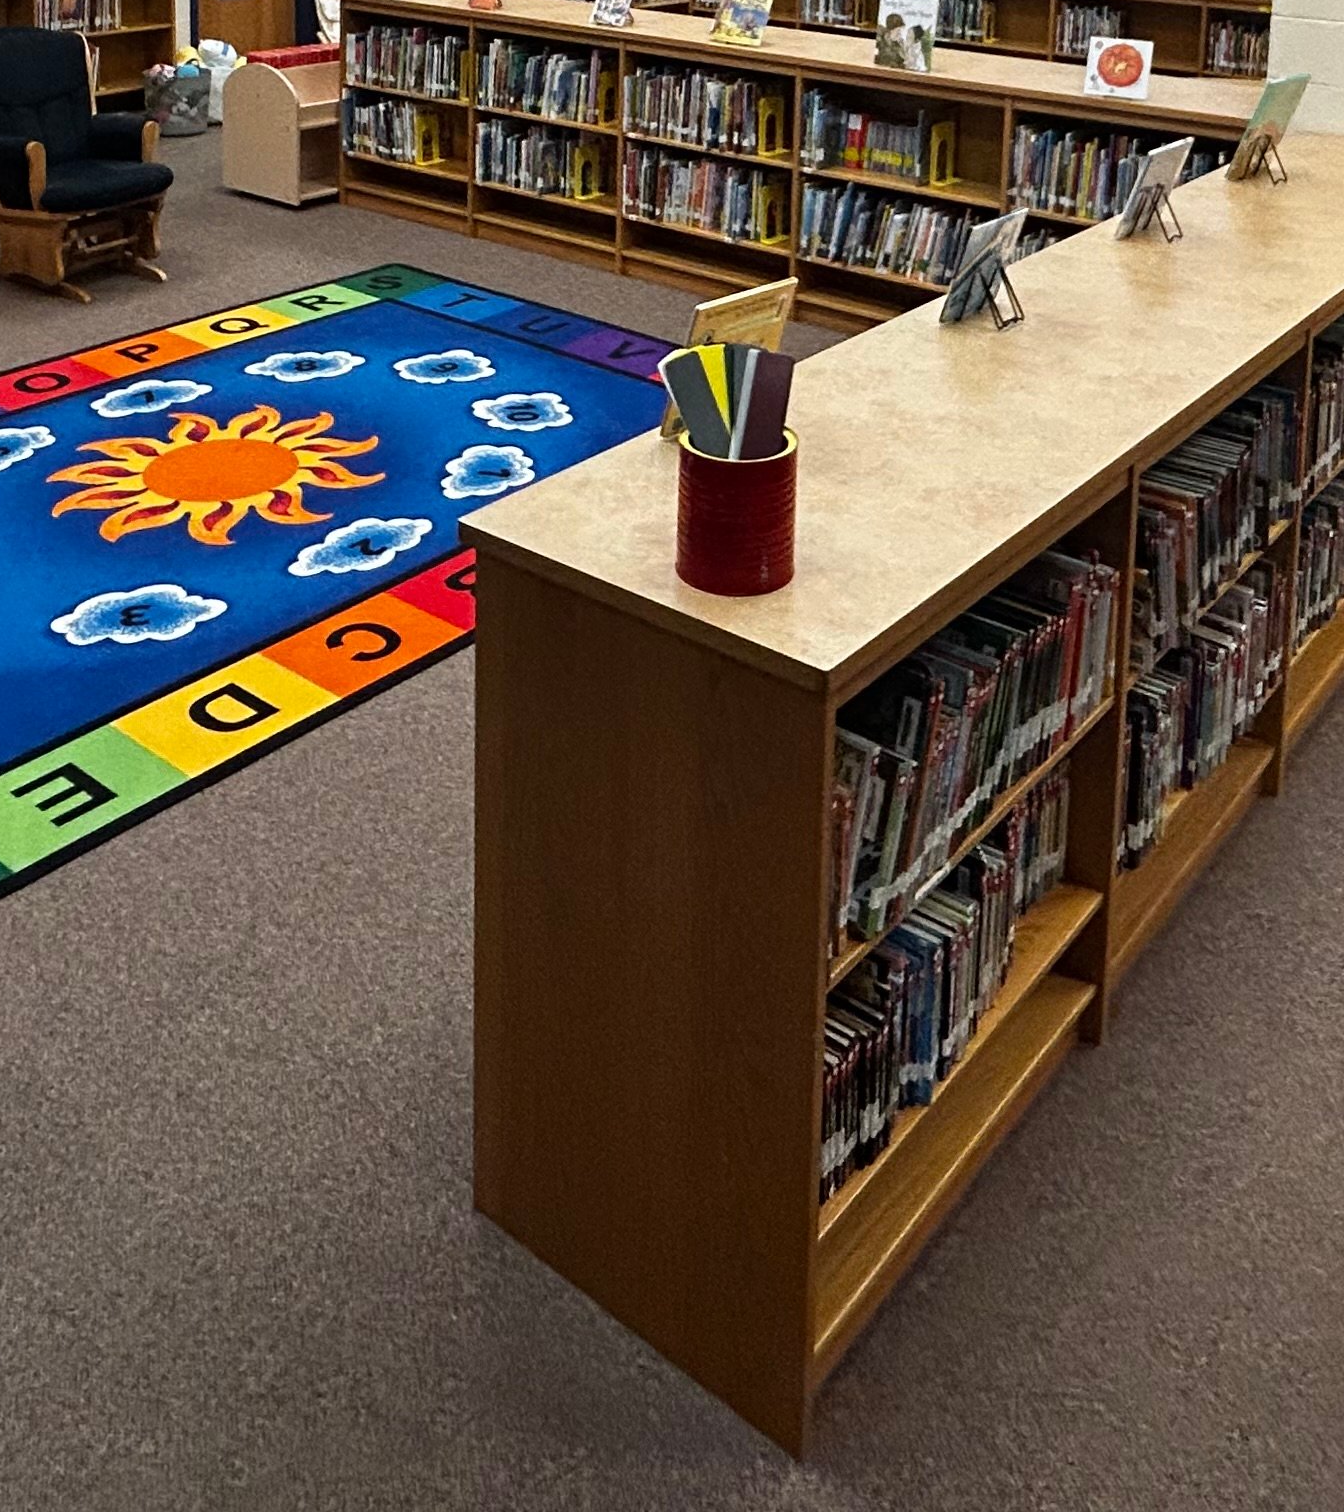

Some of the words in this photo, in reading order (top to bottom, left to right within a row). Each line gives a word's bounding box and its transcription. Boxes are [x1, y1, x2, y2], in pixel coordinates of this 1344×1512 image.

[12, 372, 70, 393] O
[115, 344, 159, 363] P
[209, 316, 271, 335] Q
[291, 294, 347, 311] R
[366, 276, 402, 289] S
[445, 292, 489, 307] T
[519, 316, 570, 334] U
[609, 341, 652, 360] V
[294, 359, 318, 372] 8
[348, 539, 388, 556] 2
[119, 604, 152, 626] 3
[11, 762, 119, 827] E
[188, 682, 281, 733] D
[325, 621, 403, 662] C
